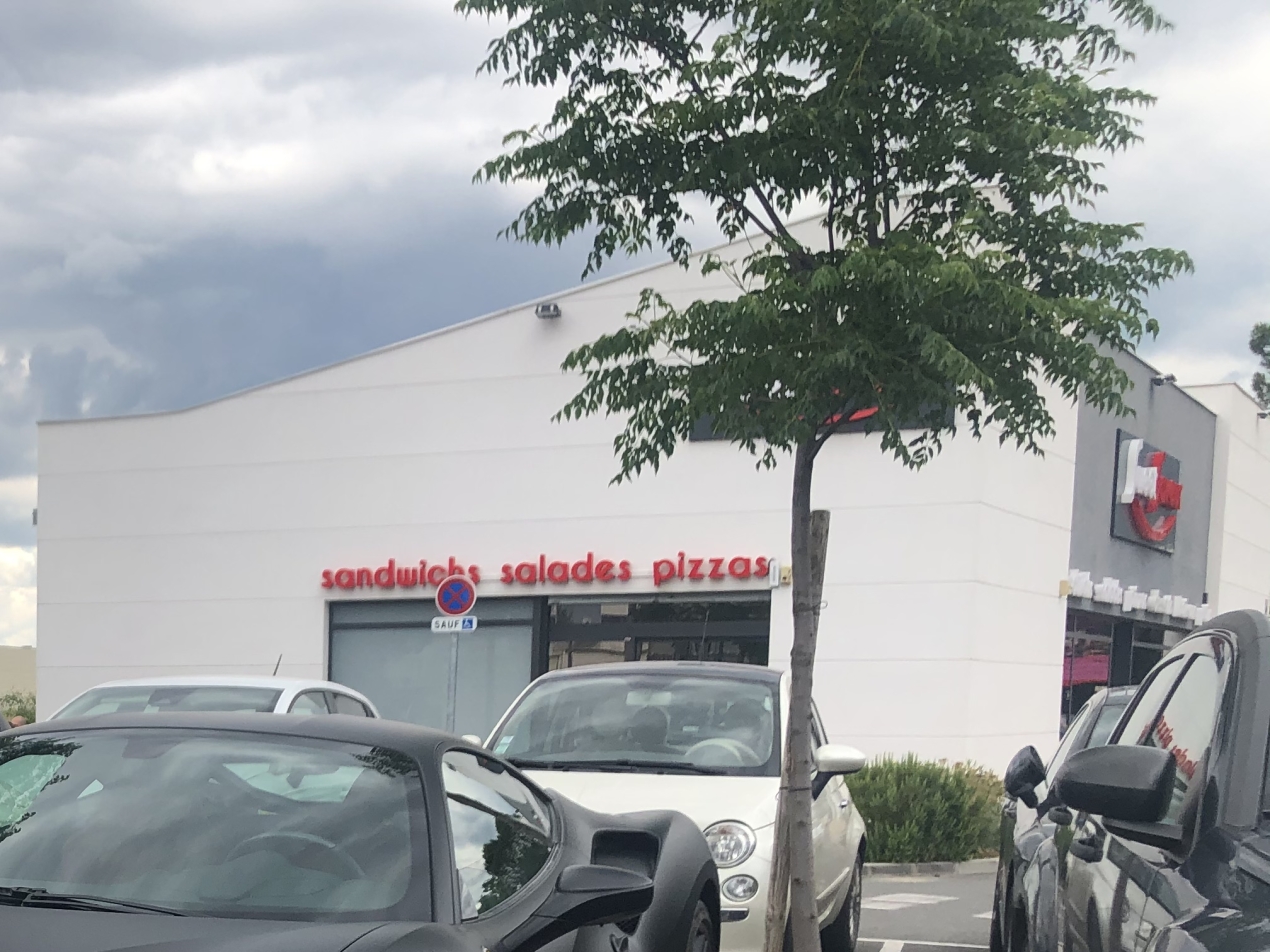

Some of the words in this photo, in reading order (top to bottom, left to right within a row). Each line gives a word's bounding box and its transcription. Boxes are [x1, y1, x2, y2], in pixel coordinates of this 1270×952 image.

[322, 556, 481, 588] sandwichs
[501, 552, 631, 584] salades
[653, 551, 769, 587] pizzas
[434, 619, 460, 630] SAUF
